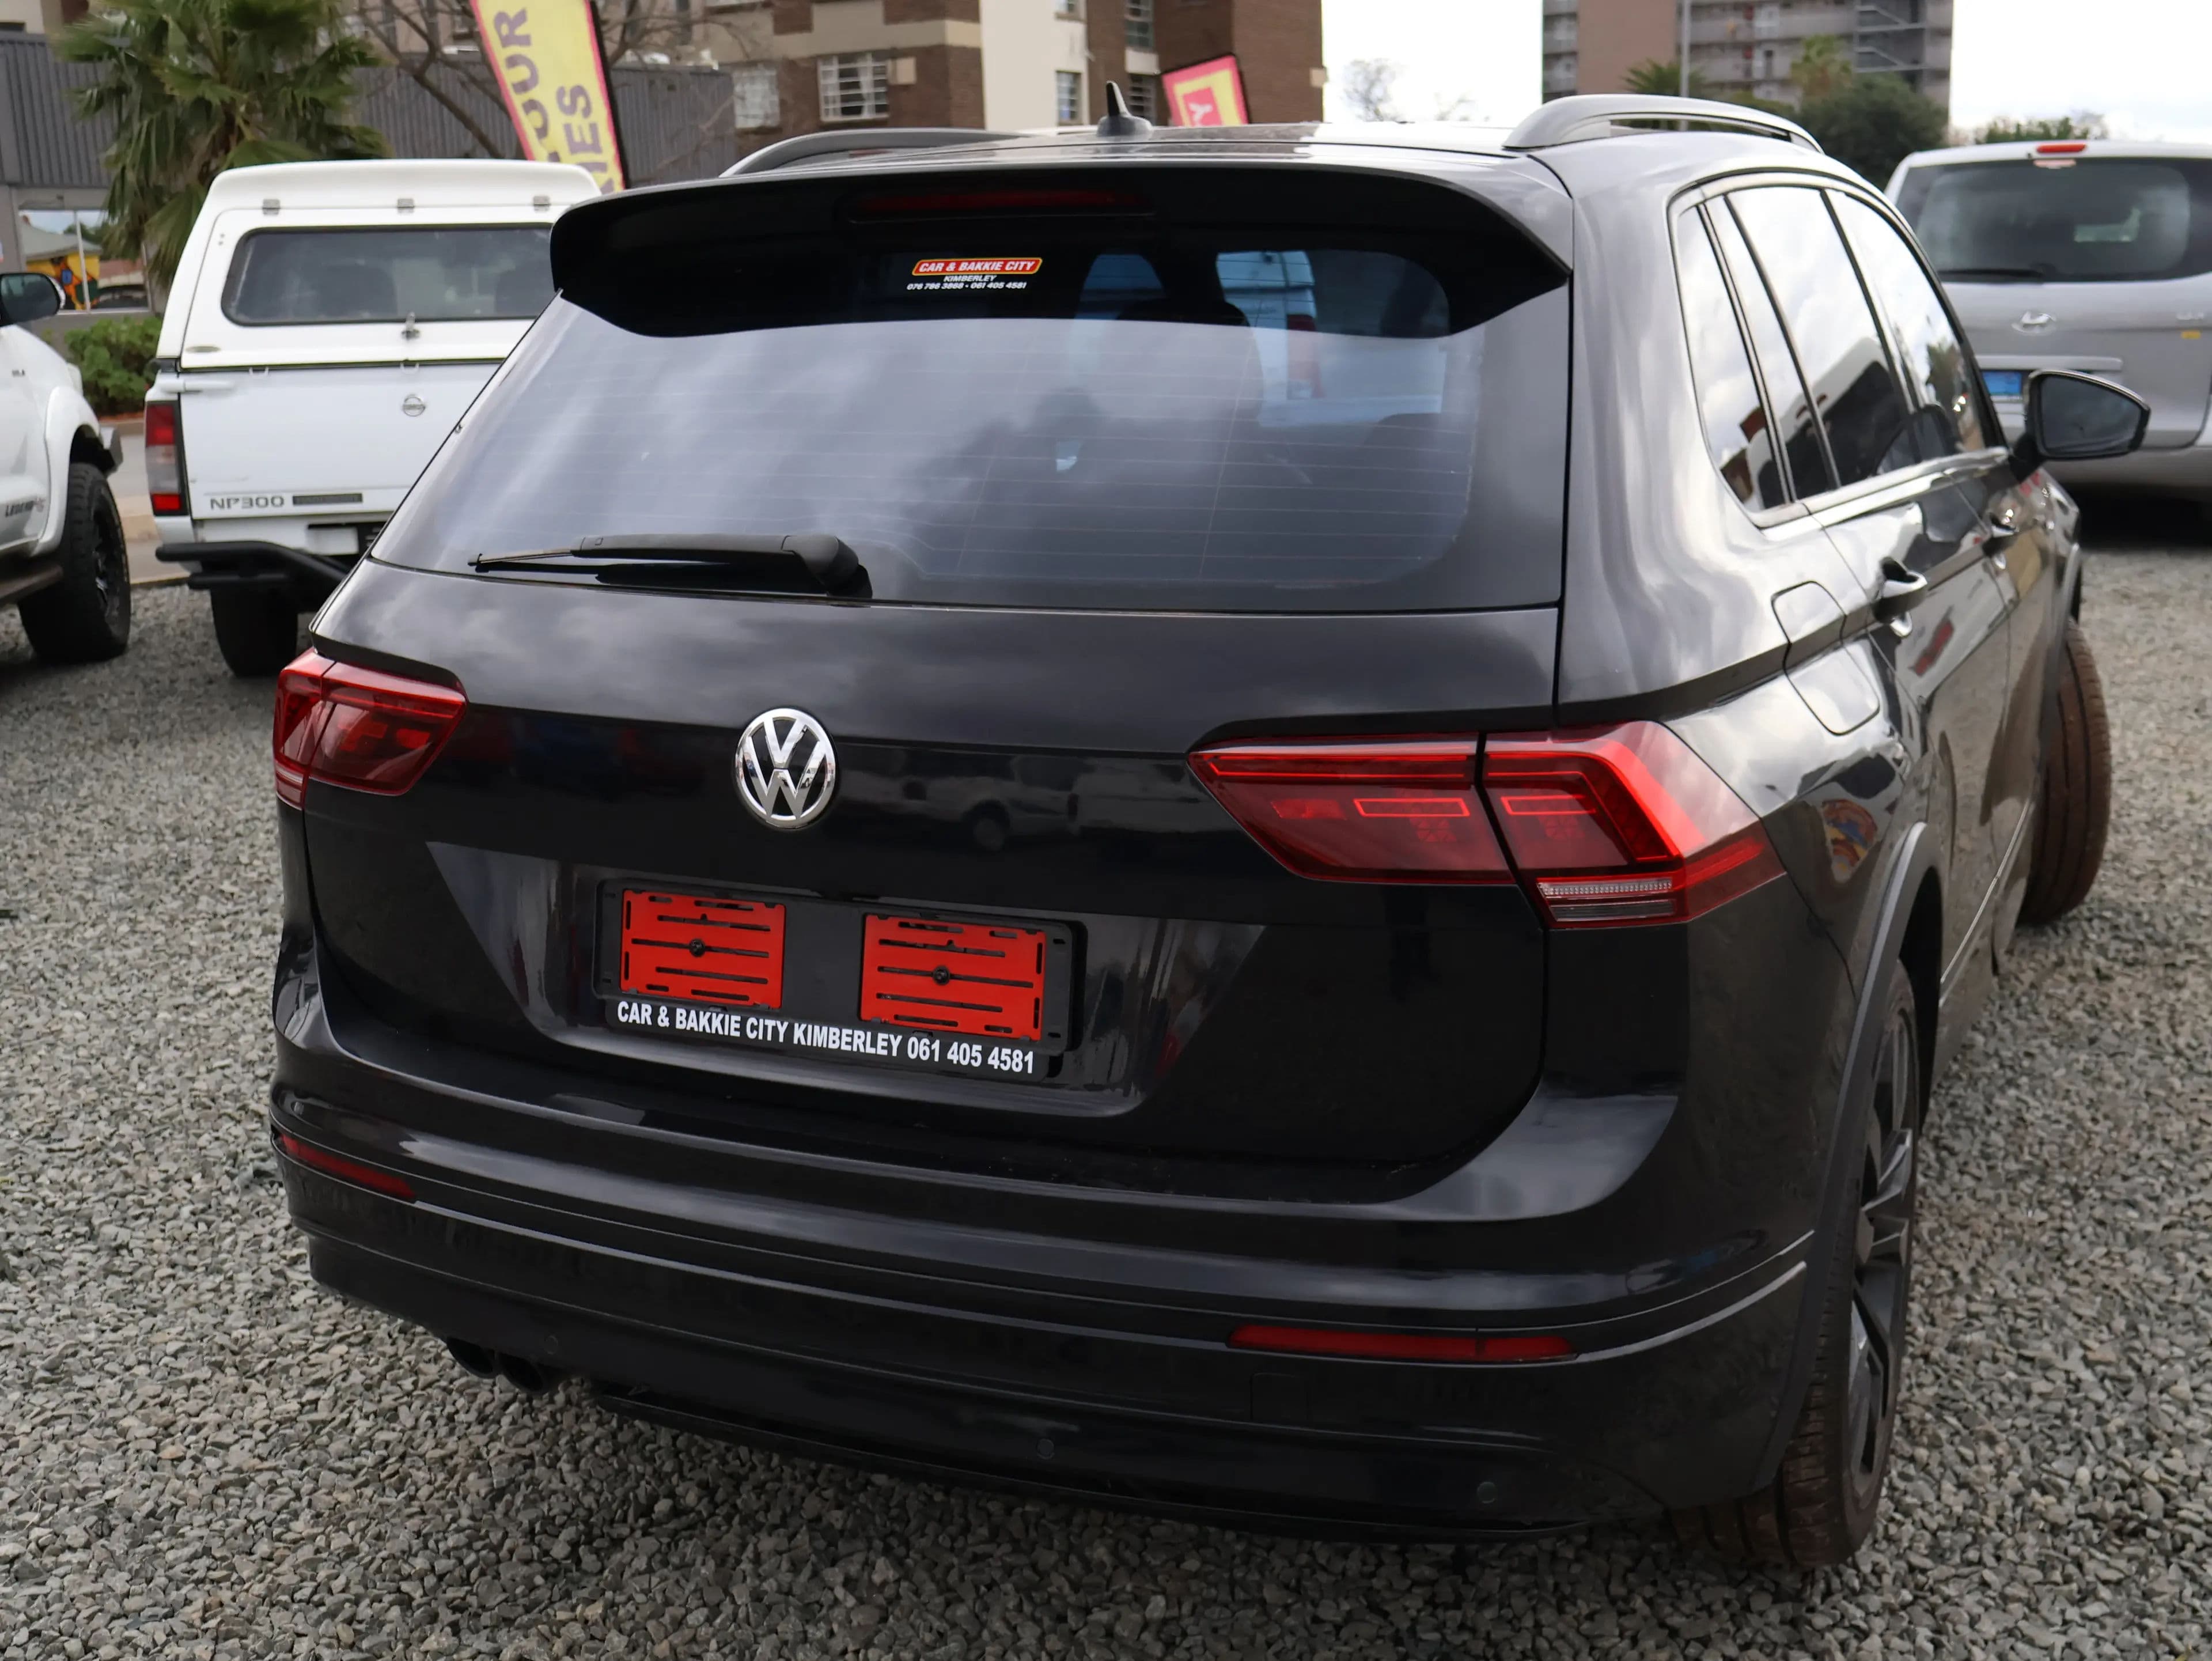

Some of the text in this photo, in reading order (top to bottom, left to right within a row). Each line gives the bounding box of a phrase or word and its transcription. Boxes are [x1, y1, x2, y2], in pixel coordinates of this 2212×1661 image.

[919, 260, 1036, 272] CAR & BAKKIE CITY
[210, 495, 285, 510] NP300
[618, 1001, 1034, 1074] CAR & BAKKIE CITY KIMBERLEY 061 405 4581
